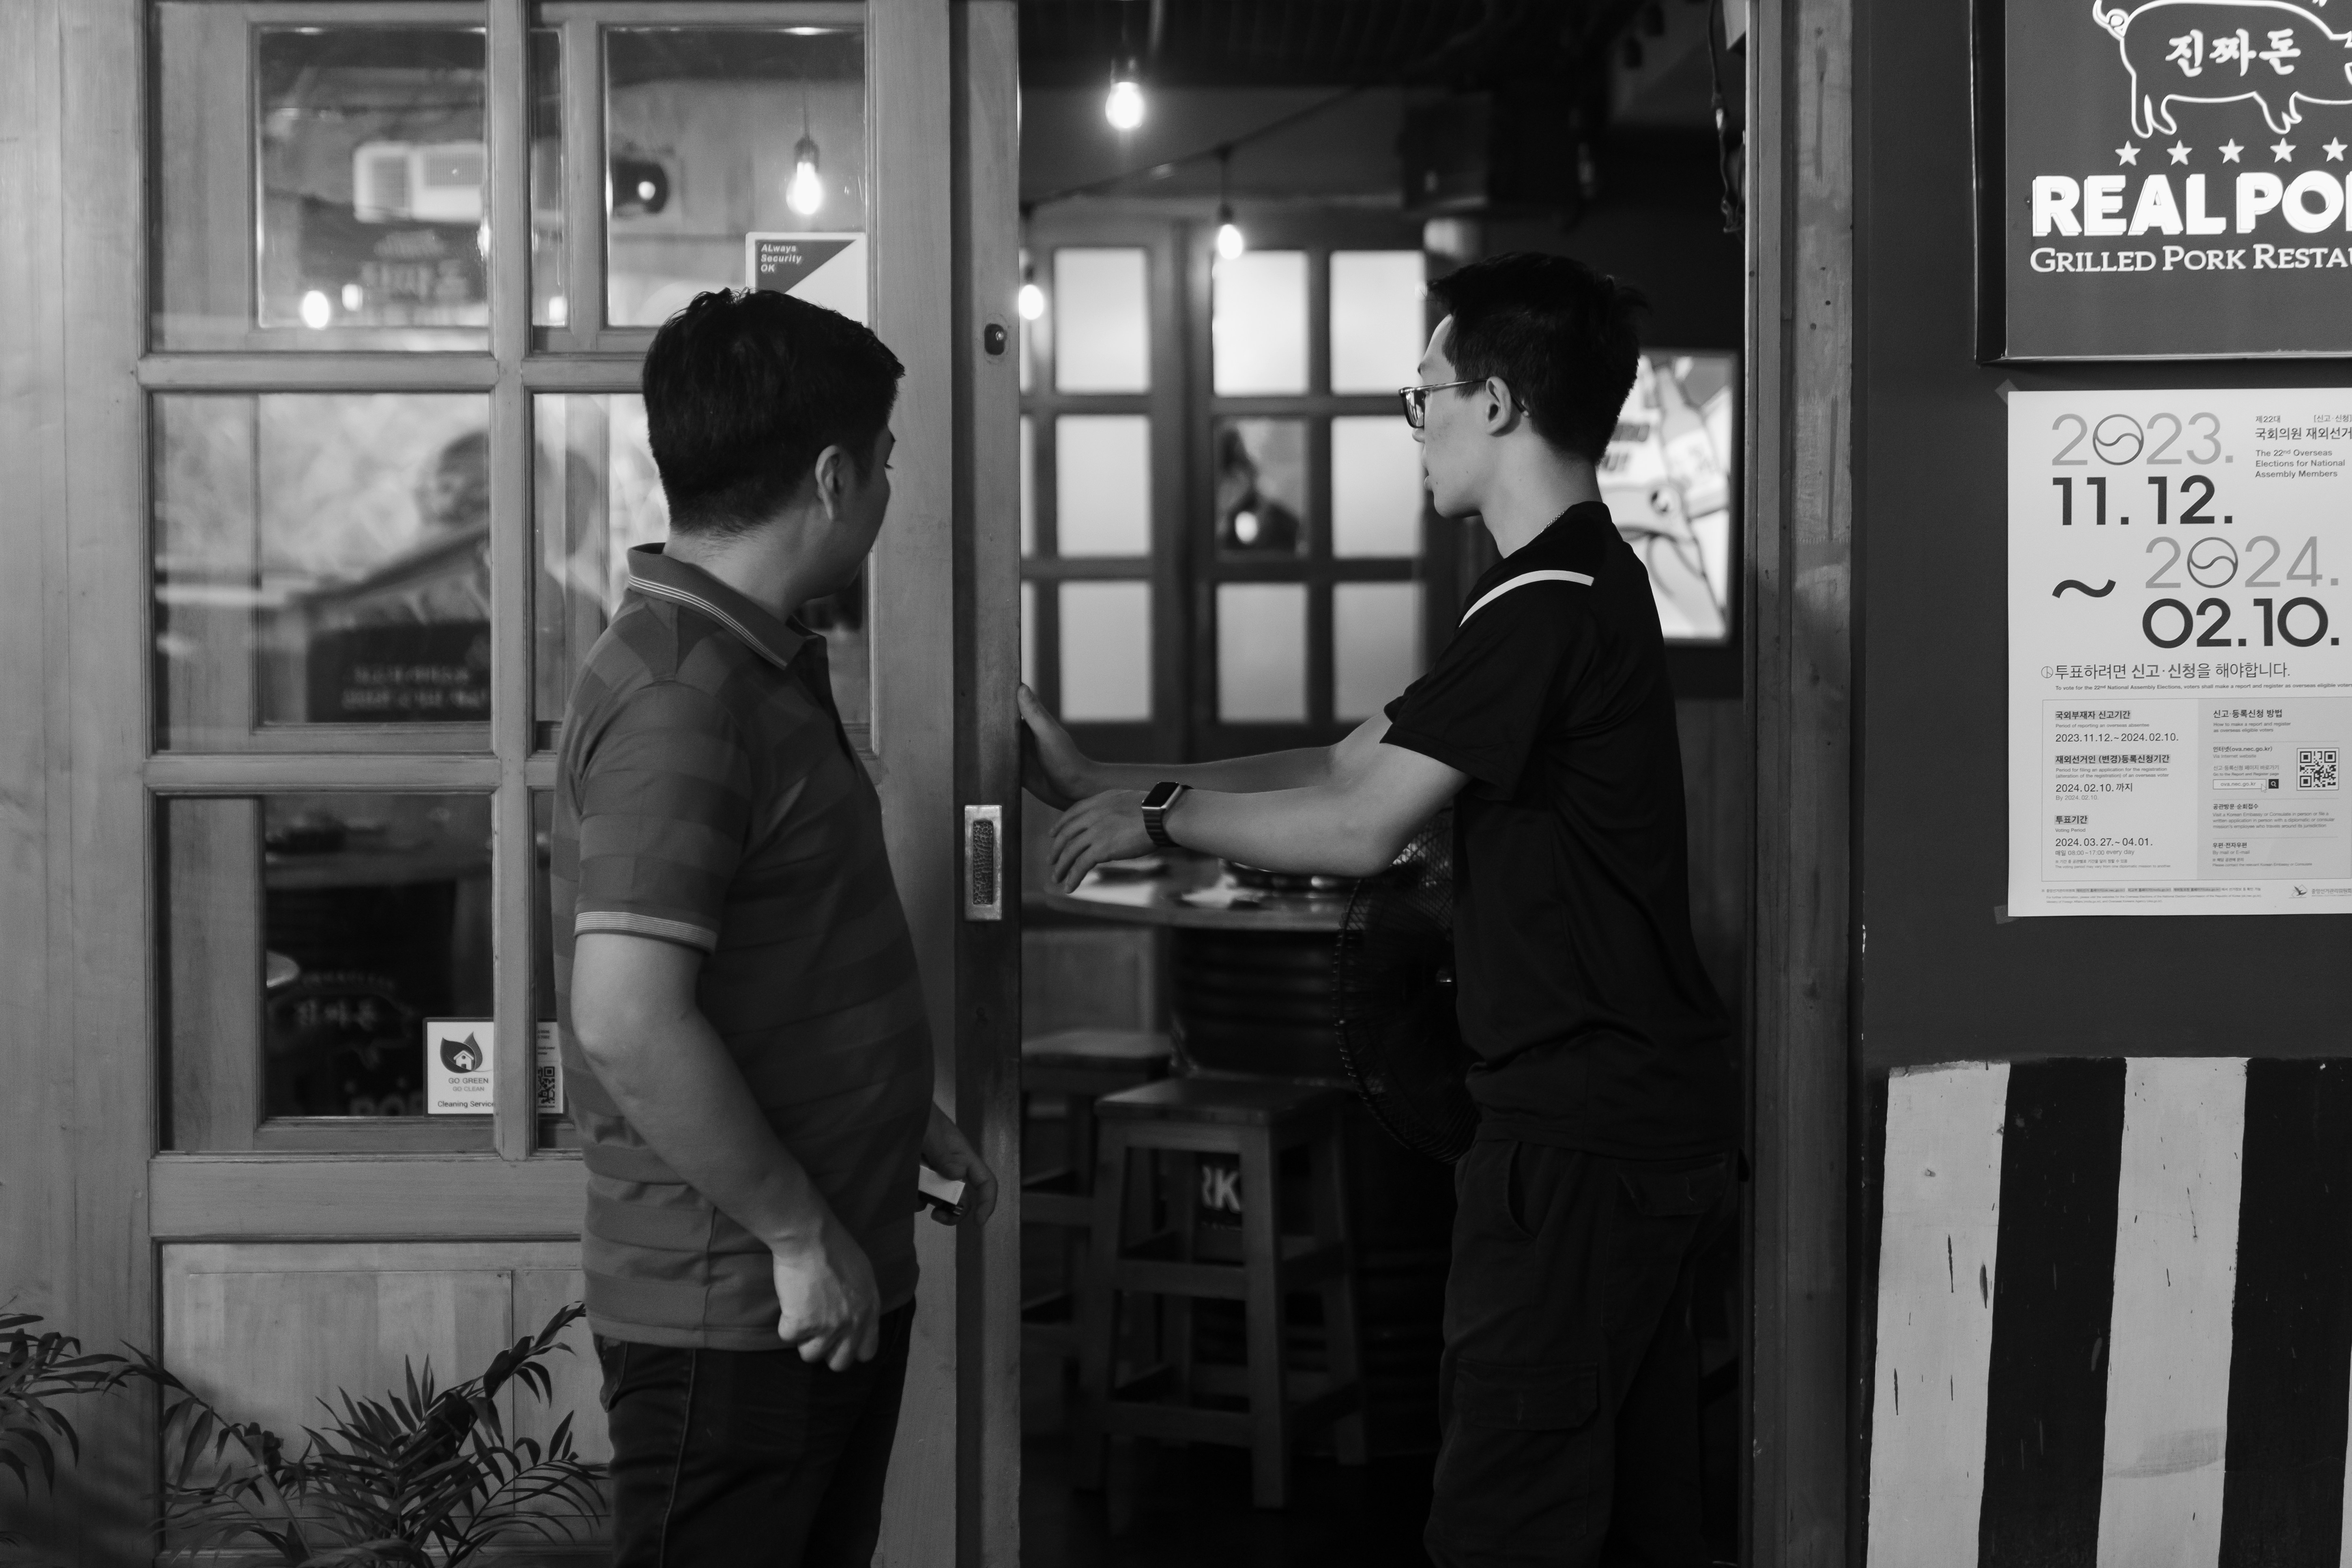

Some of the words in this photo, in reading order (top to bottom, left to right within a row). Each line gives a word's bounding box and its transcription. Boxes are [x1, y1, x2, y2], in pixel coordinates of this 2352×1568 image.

[2165, 28, 2301, 77] 진짜돈
[2033, 174, 2226, 236] REAL
[2236, 171, 2352, 233] PO
[760, 254, 802, 264] Security
[2030, 247, 2156, 272] GRILLED
[2162, 246, 2246, 270] PORK
[2253, 244, 2352, 268] RESTA
[2255, 427, 2301, 440] 국회의원
[2306, 427, 2352, 439] 재외선거
[2055, 664, 2126, 679] 투표하려면
[2131, 664, 2211, 679] 신고·신청을
[2215, 663, 2290, 678] 해야합니다.
[2056, 711, 2096, 720] 국외부재자
[2099, 711, 2131, 719] 신고기간
[2099, 755, 2169, 763] (변경)등록신청기간
[2056, 816, 2088, 824] 투표기간
